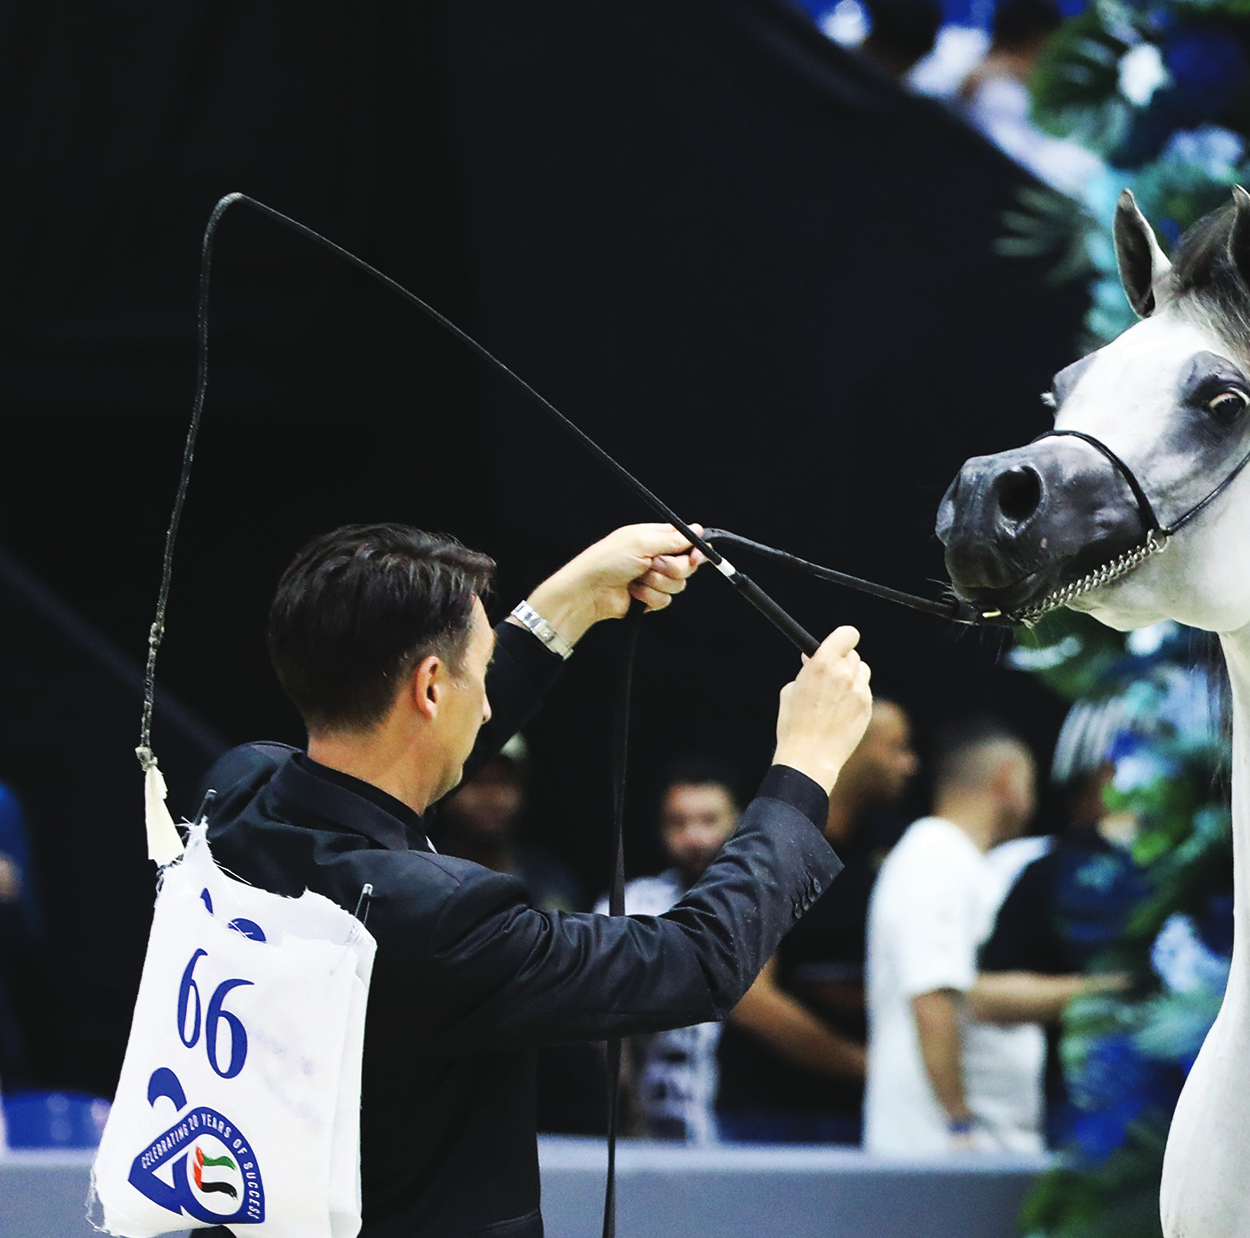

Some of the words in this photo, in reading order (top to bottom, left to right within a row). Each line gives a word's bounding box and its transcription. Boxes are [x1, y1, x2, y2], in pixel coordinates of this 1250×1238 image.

[177, 948, 255, 1079] 66
[141, 1123, 189, 1169] CELEBRATING
[188, 1114, 199, 1131] 20
[201, 1113, 232, 1138] YEARS
[233, 1139, 248, 1155] OF
